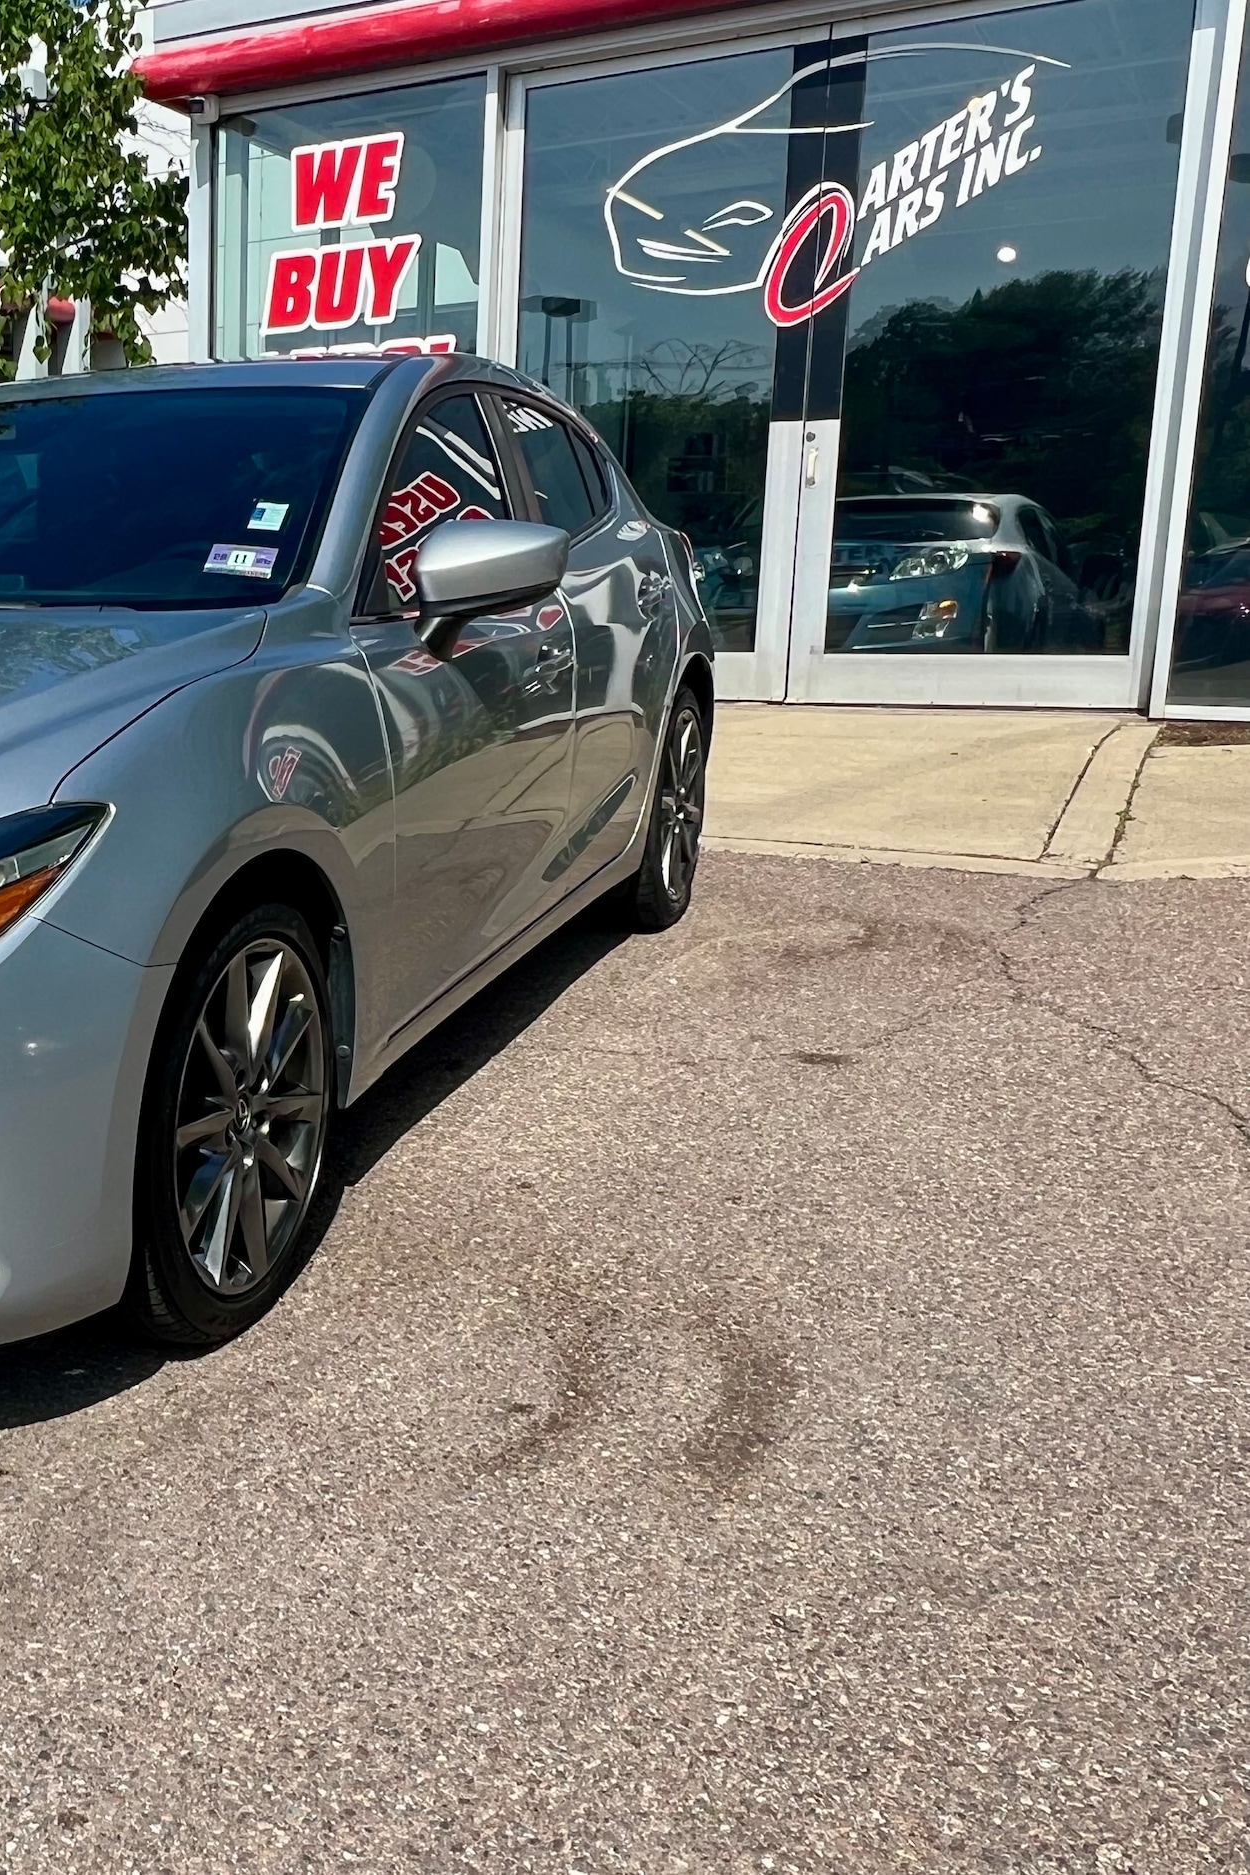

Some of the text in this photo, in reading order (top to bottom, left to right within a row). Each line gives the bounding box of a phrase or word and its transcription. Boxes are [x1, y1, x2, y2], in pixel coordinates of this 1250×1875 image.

[293, 134, 402, 230] WE
[955, 115, 1043, 208] INC.
[263, 237, 419, 333] BUY
